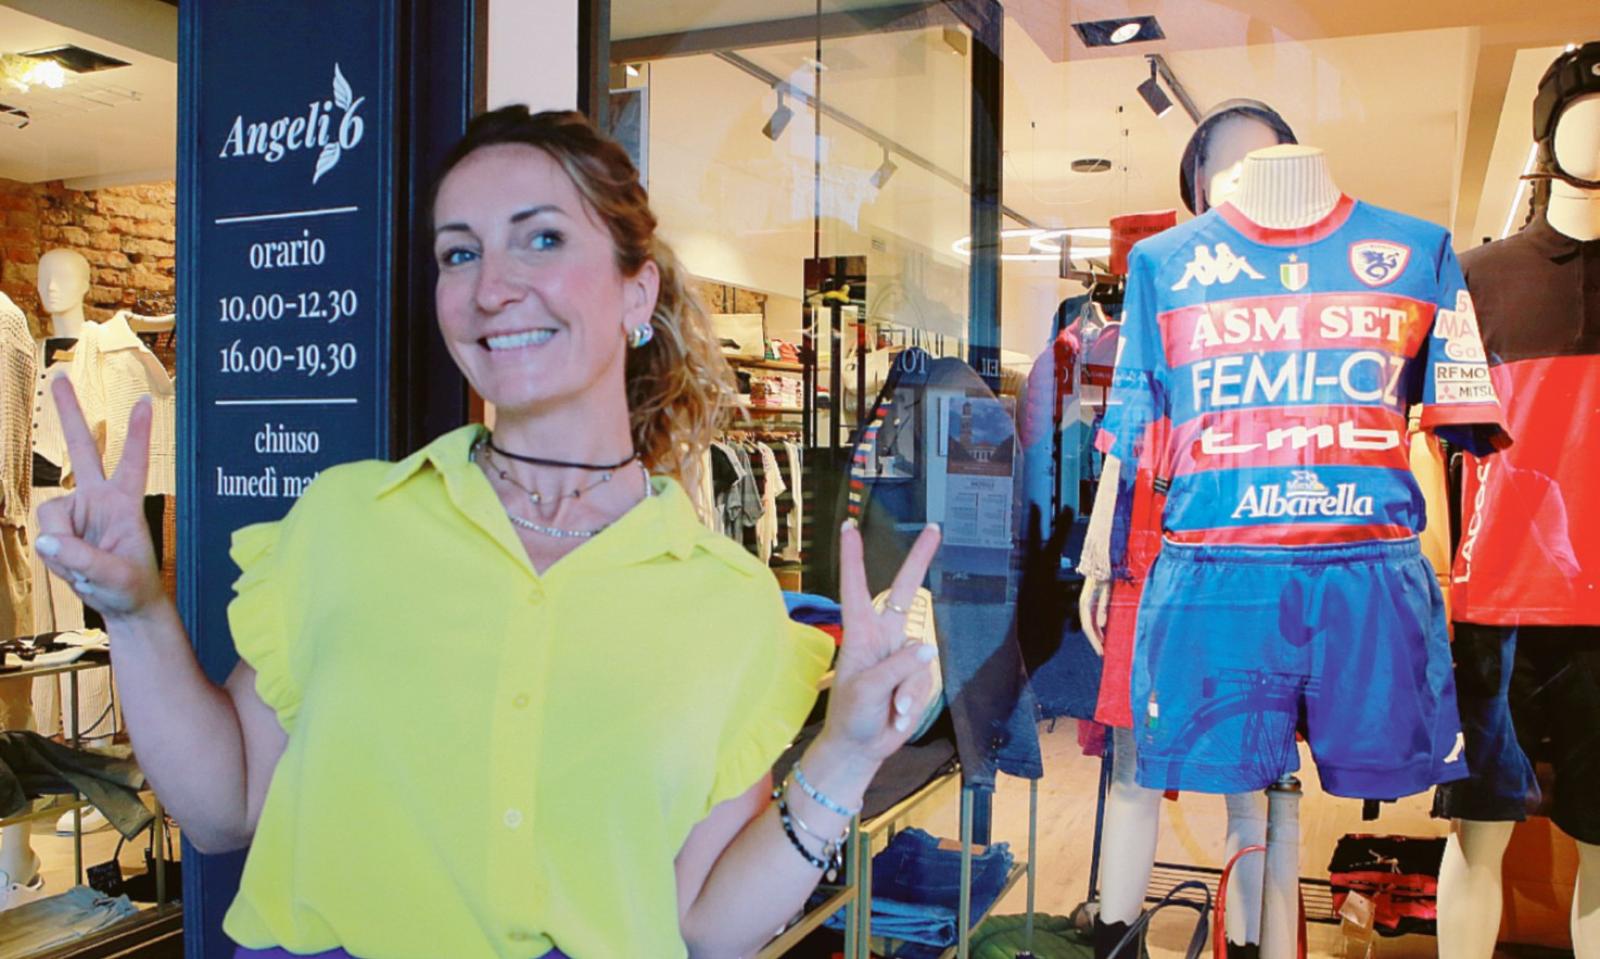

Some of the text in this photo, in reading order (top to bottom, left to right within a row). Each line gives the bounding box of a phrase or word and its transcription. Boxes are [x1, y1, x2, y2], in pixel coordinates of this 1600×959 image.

[219, 100, 332, 163] Angeli
[249, 228, 326, 270] orario
[218, 289, 358, 324] 10.00-12.30
[1189, 305, 1408, 351] ASM SET
[219, 338, 358, 377] 16.00-19.30
[1190, 350, 1406, 412] FEMI-CZ
[254, 422, 320, 454] chiuso
[1200, 420, 1400, 455] tmb
[216, 466, 278, 498] lunedì
[1231, 481, 1374, 519] Albarella
